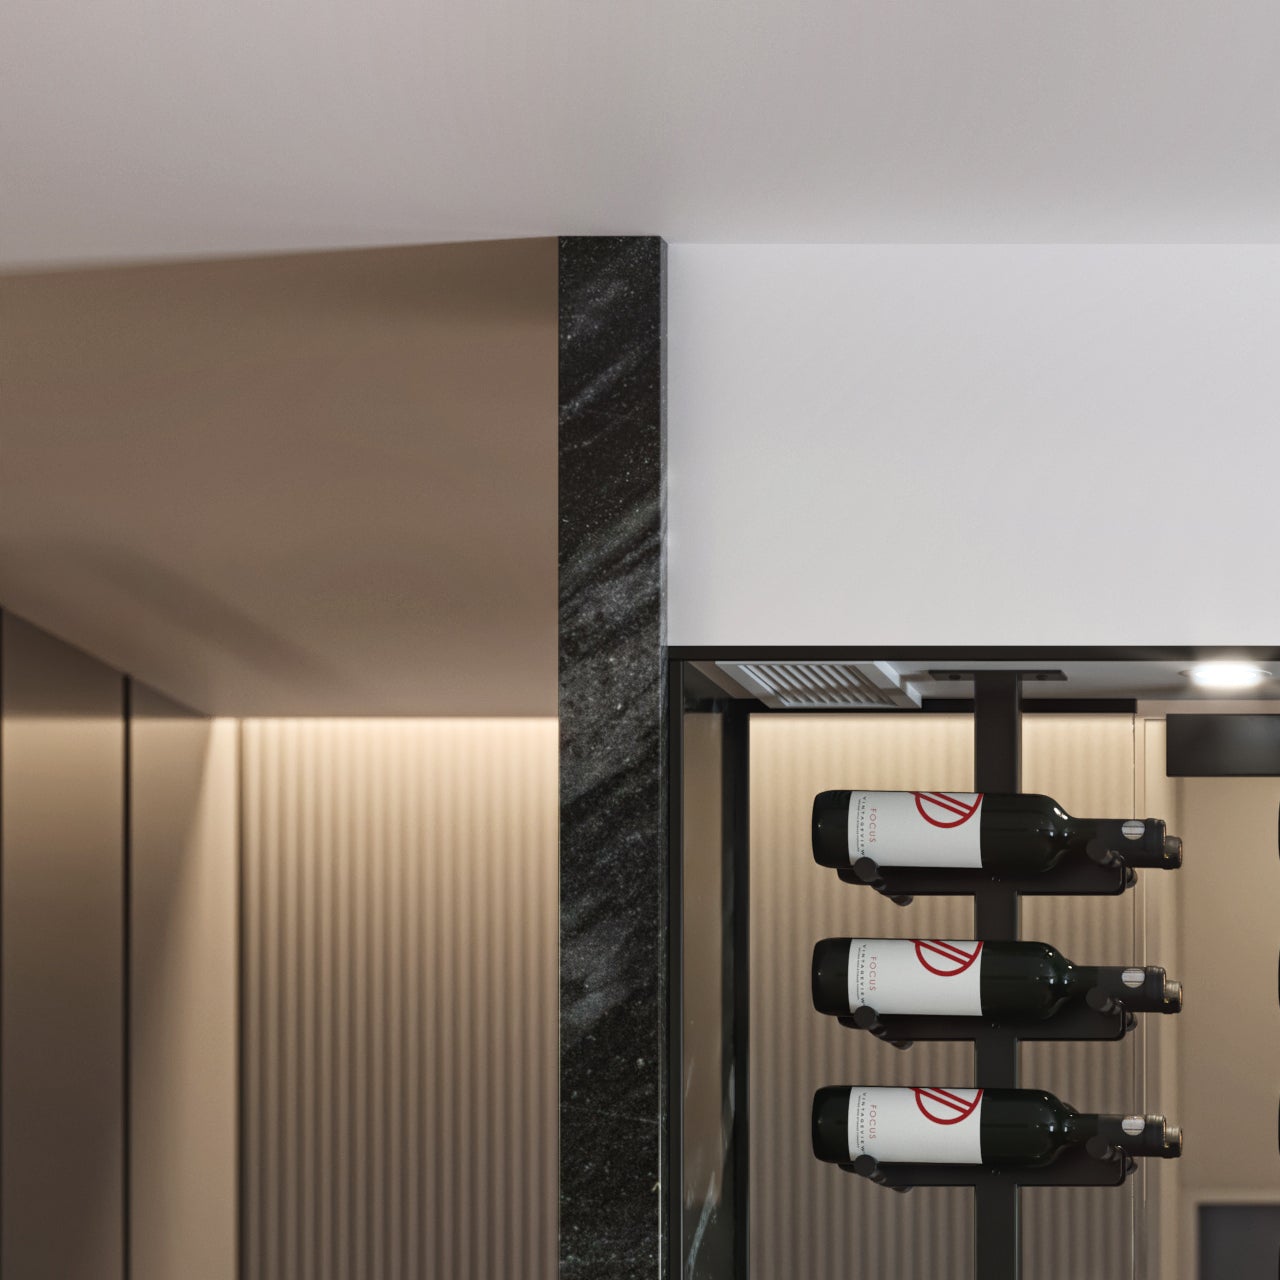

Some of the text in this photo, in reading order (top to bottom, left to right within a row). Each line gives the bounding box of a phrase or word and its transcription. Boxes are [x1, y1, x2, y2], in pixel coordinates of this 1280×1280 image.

[869, 808, 877, 843] FOCUS
[869, 956, 877, 991] FOCUS
[869, 1104, 877, 1139] FOCUS
